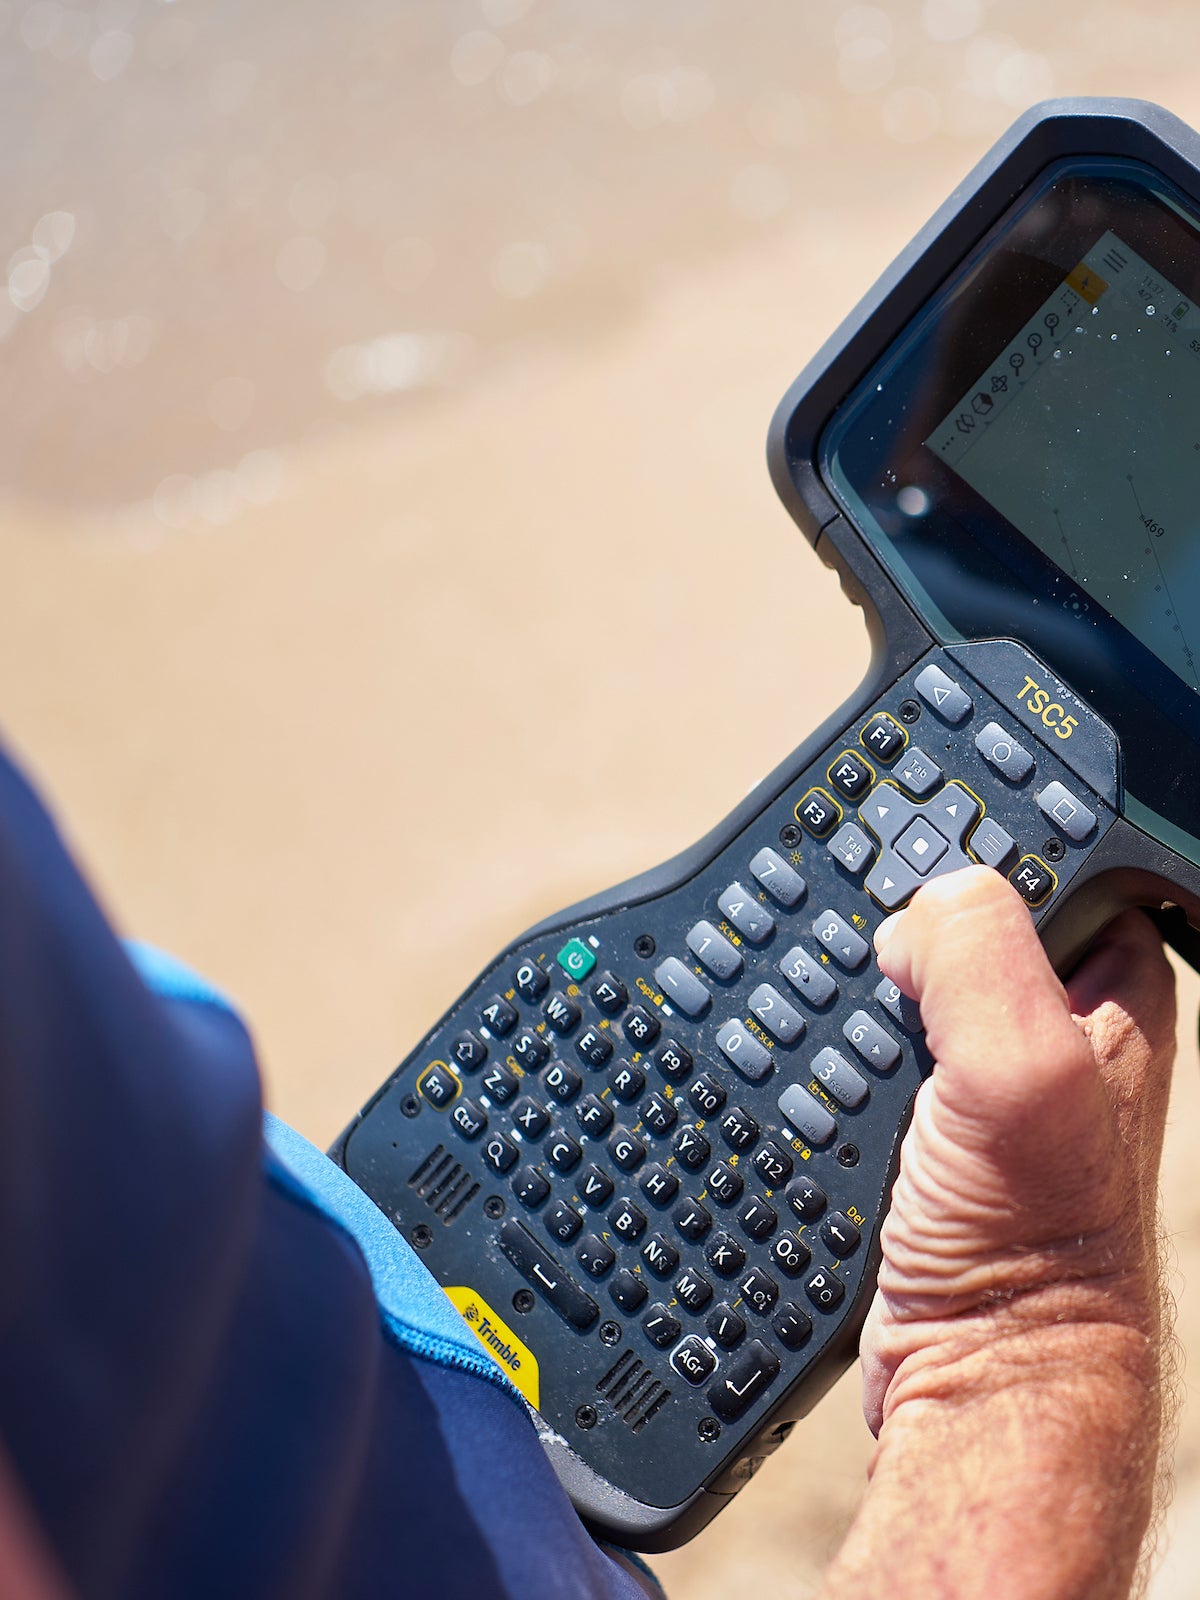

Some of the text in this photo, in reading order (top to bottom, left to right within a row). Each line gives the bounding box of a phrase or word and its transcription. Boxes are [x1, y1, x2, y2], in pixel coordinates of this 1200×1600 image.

[1143, 518, 1165, 539] 469
[1016, 675, 1081, 740] TSC5
[870, 726, 891, 750] F1
[836, 763, 860, 788] F2
[910, 759, 928, 779] Tab
[803, 800, 827, 825] F3
[845, 834, 864, 856] Tab
[760, 861, 778, 879] 7
[1017, 867, 1041, 892] F4
[728, 901, 744, 918] 4
[718, 921, 736, 940] SCR
[822, 922, 839, 941] 8
[699, 937, 712, 954] 1
[516, 965, 533, 988] Q
[788, 958, 804, 978] 5
[596, 983, 616, 1003] F7
[635, 977, 655, 1000] Caps
[885, 985, 901, 1003] 9
[483, 1004, 499, 1023] A
[547, 997, 567, 1020] W
[756, 999, 774, 1017] 2
[628, 1016, 648, 1038] F8
[744, 1017, 775, 1049] PRT SCR
[851, 1024, 868, 1043] 6
[515, 1035, 532, 1053] S
[578, 1032, 595, 1051] E
[660, 1050, 682, 1071] F9
[818, 1061, 836, 1080] 3
[484, 1070, 501, 1090] Z
[546, 1067, 563, 1086] D
[615, 1070, 632, 1090] R
[425, 1076, 444, 1098] Fn
[690, 1080, 717, 1110] F10
[453, 1106, 479, 1134] Ctrl
[518, 1106, 537, 1128] X
[583, 1106, 601, 1123] F
[645, 1101, 661, 1119] T
[722, 1115, 750, 1143] F11
[615, 1141, 633, 1160] G
[677, 1133, 694, 1151] Y
[552, 1143, 569, 1162] C
[755, 1149, 784, 1179] F12
[585, 1175, 602, 1195] V
[646, 1173, 666, 1195] H
[709, 1168, 726, 1188] U
[615, 1212, 632, 1231] B
[679, 1212, 696, 1227] J
[846, 1205, 867, 1227] Del
[643, 1240, 662, 1263] N
[713, 1245, 732, 1266] K
[676, 1275, 696, 1298] M
[741, 1275, 755, 1295] L
[808, 1273, 825, 1289] P
[477, 1317, 521, 1371] Trimble
[677, 1349, 705, 1375] AGr
